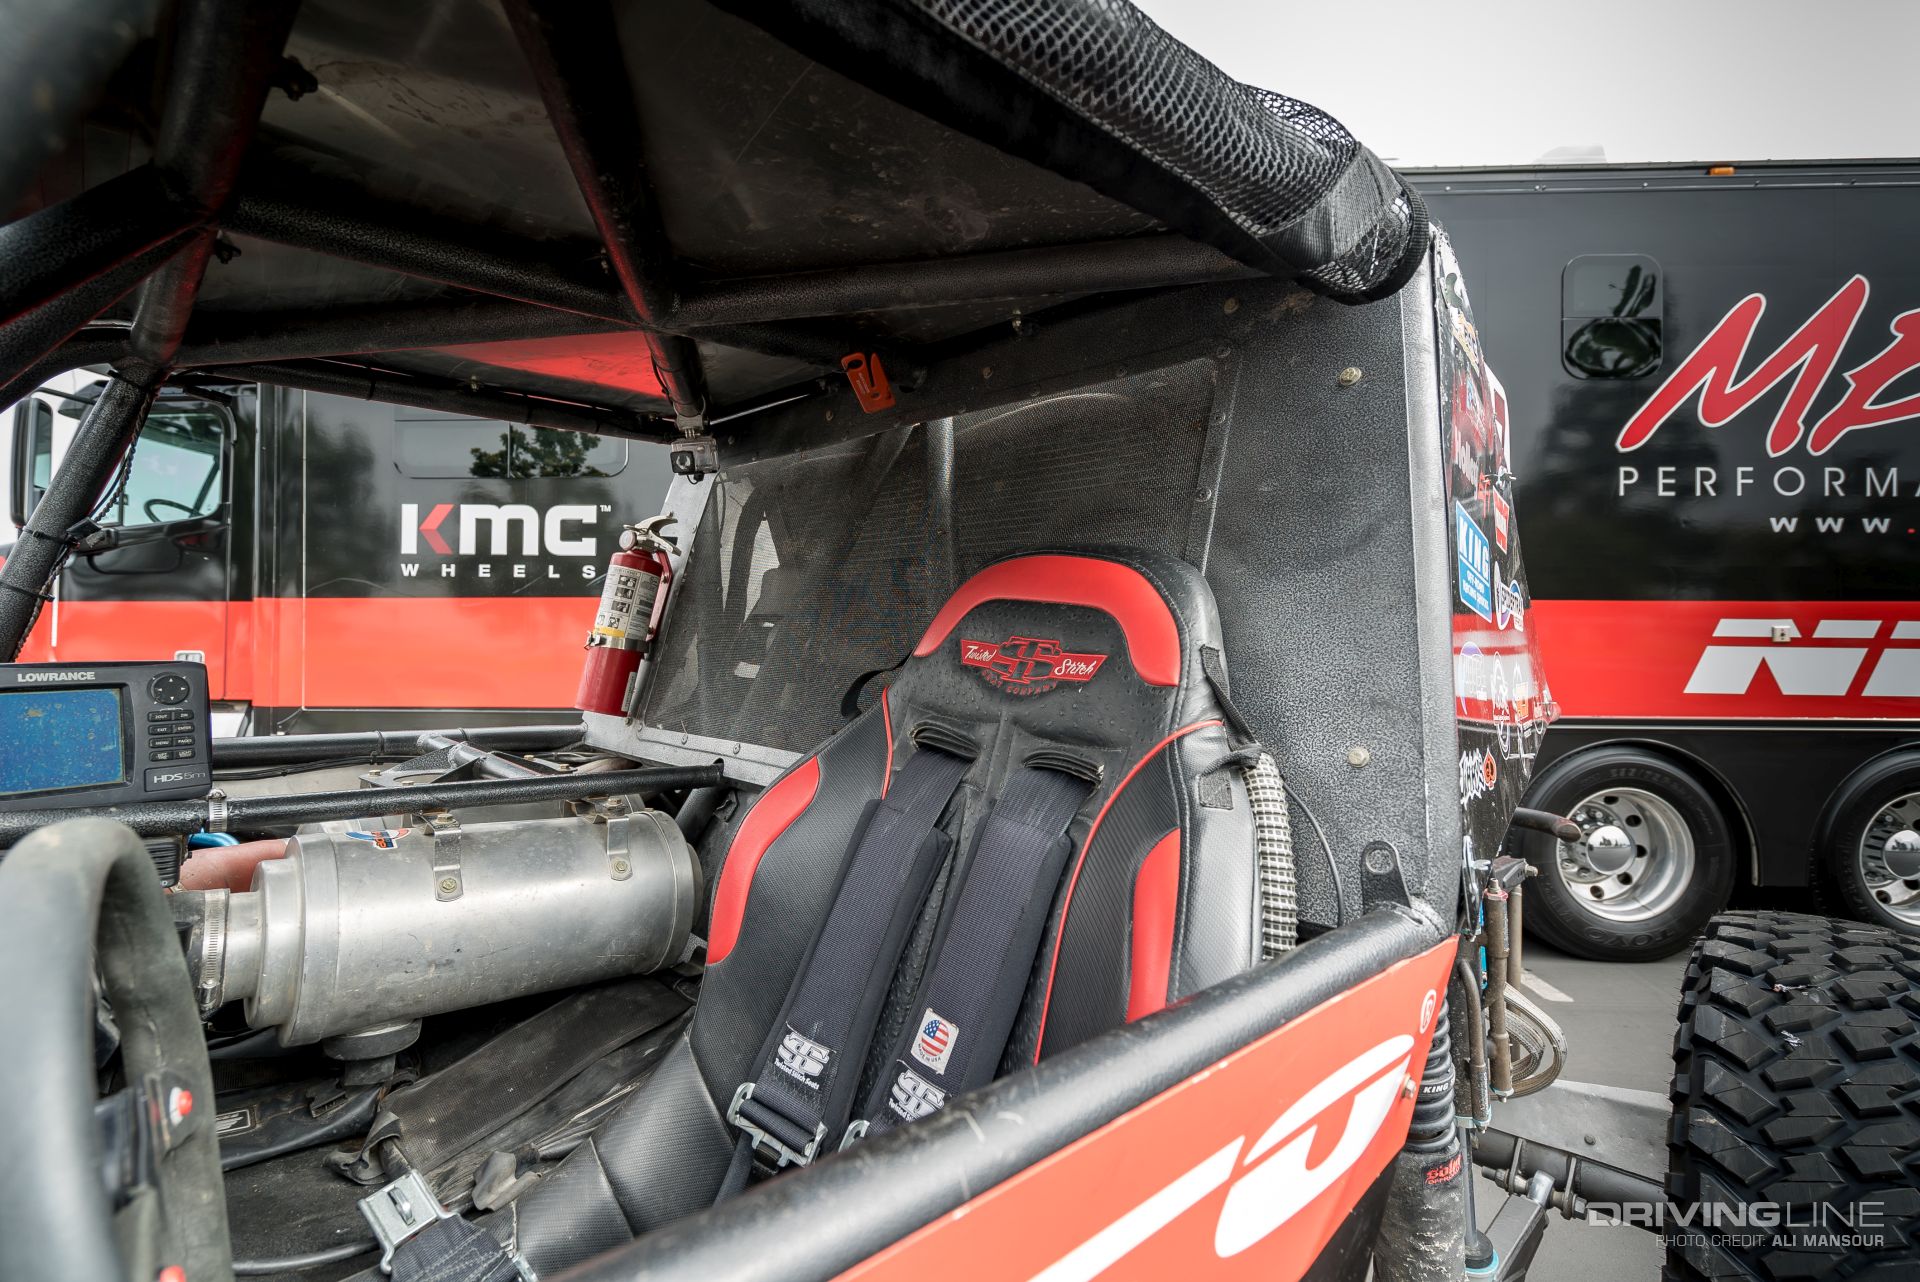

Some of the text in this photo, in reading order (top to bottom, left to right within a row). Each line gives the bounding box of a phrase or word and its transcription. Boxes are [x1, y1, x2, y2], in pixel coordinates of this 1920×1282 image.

[1619, 467, 1920, 497] PERFORM
[1459, 516, 1489, 581] KING
[400, 563, 596, 579] WHEELS
[964, 645, 1097, 675] Twisted Stitch
[17, 671, 96, 683] LOWRANCE
[774, 1057, 820, 1090] Twisted Stitch Seats
[1423, 1083, 1448, 1093] KING
